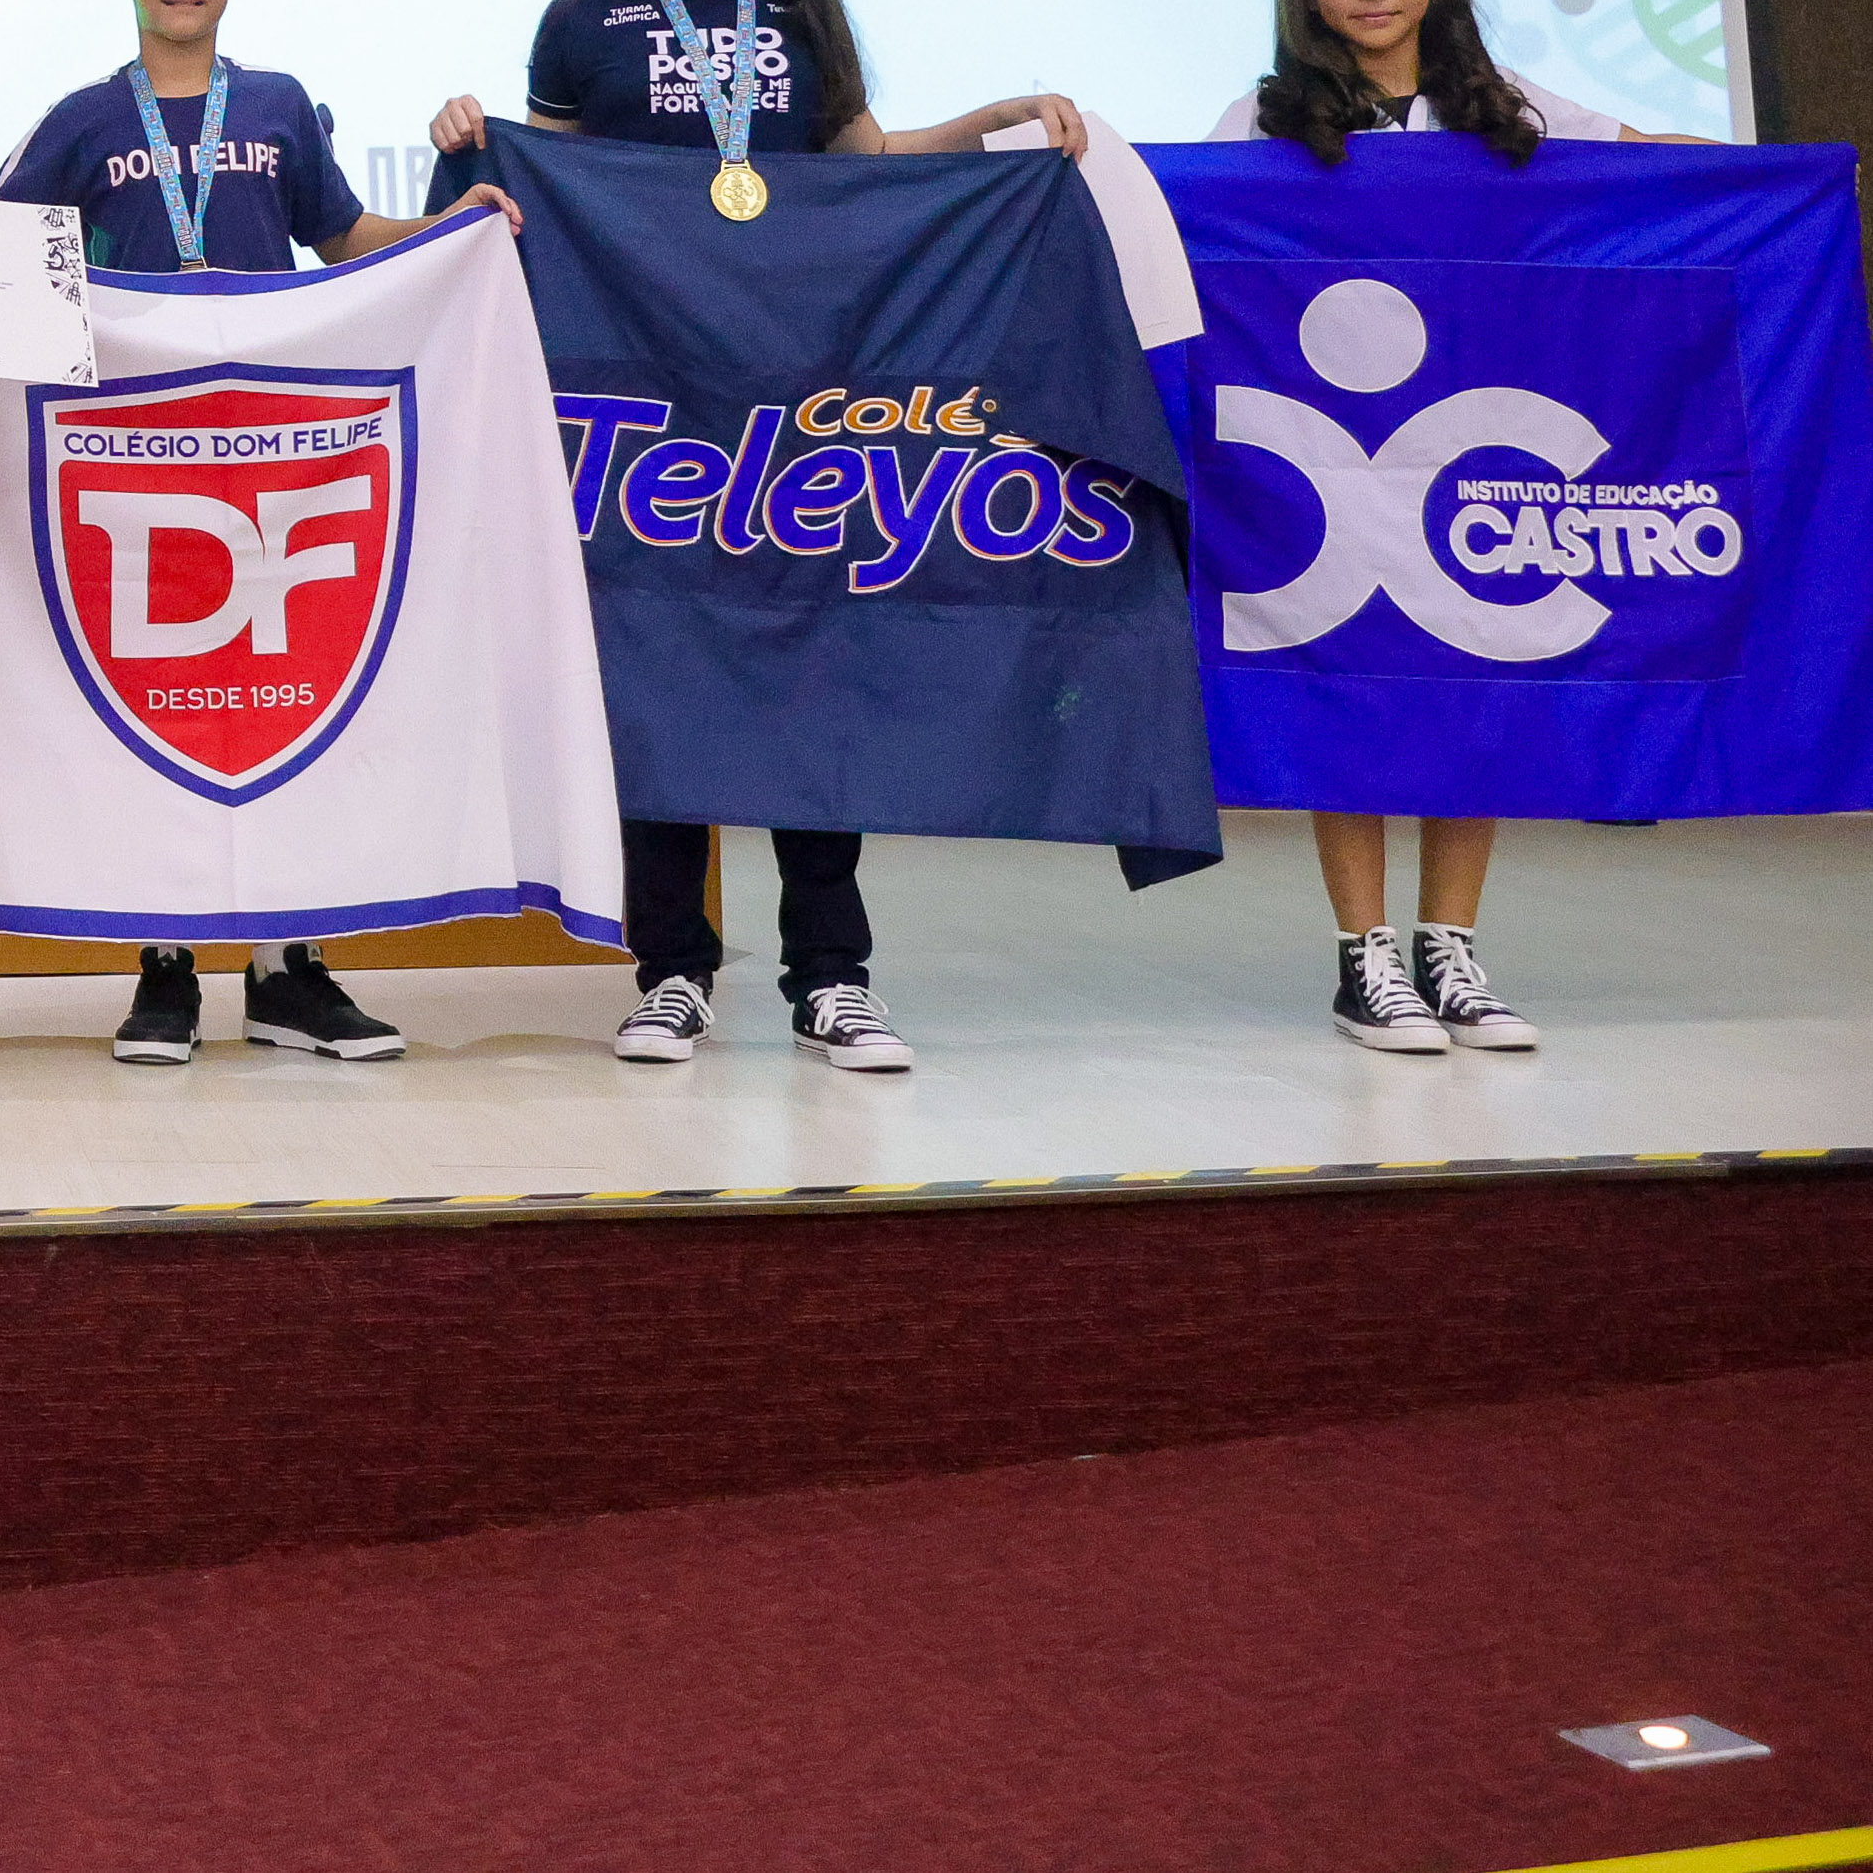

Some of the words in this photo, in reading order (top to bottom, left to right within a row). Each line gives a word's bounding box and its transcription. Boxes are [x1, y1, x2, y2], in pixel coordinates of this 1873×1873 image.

[603, 10, 661, 27] OLÍMPICA
[610, 3, 654, 16] TURMA
[649, 49, 789, 82] POSO
[769, 78, 792, 91] ME
[63, 431, 201, 459] COLÉGIO
[210, 431, 283, 458] DOM
[293, 416, 383, 454] FELIPE
[552, 391, 1135, 594] Teleyos
[1457, 480, 1561, 503] INSTITUTO
[1564, 483, 1593, 504] DE
[1595, 480, 1720, 510] EDUCAÇÃO
[1449, 503, 1743, 577] CASTRO
[77, 473, 373, 659] DF
[147, 685, 244, 711] DESDE
[250, 682, 316, 709] 1995
